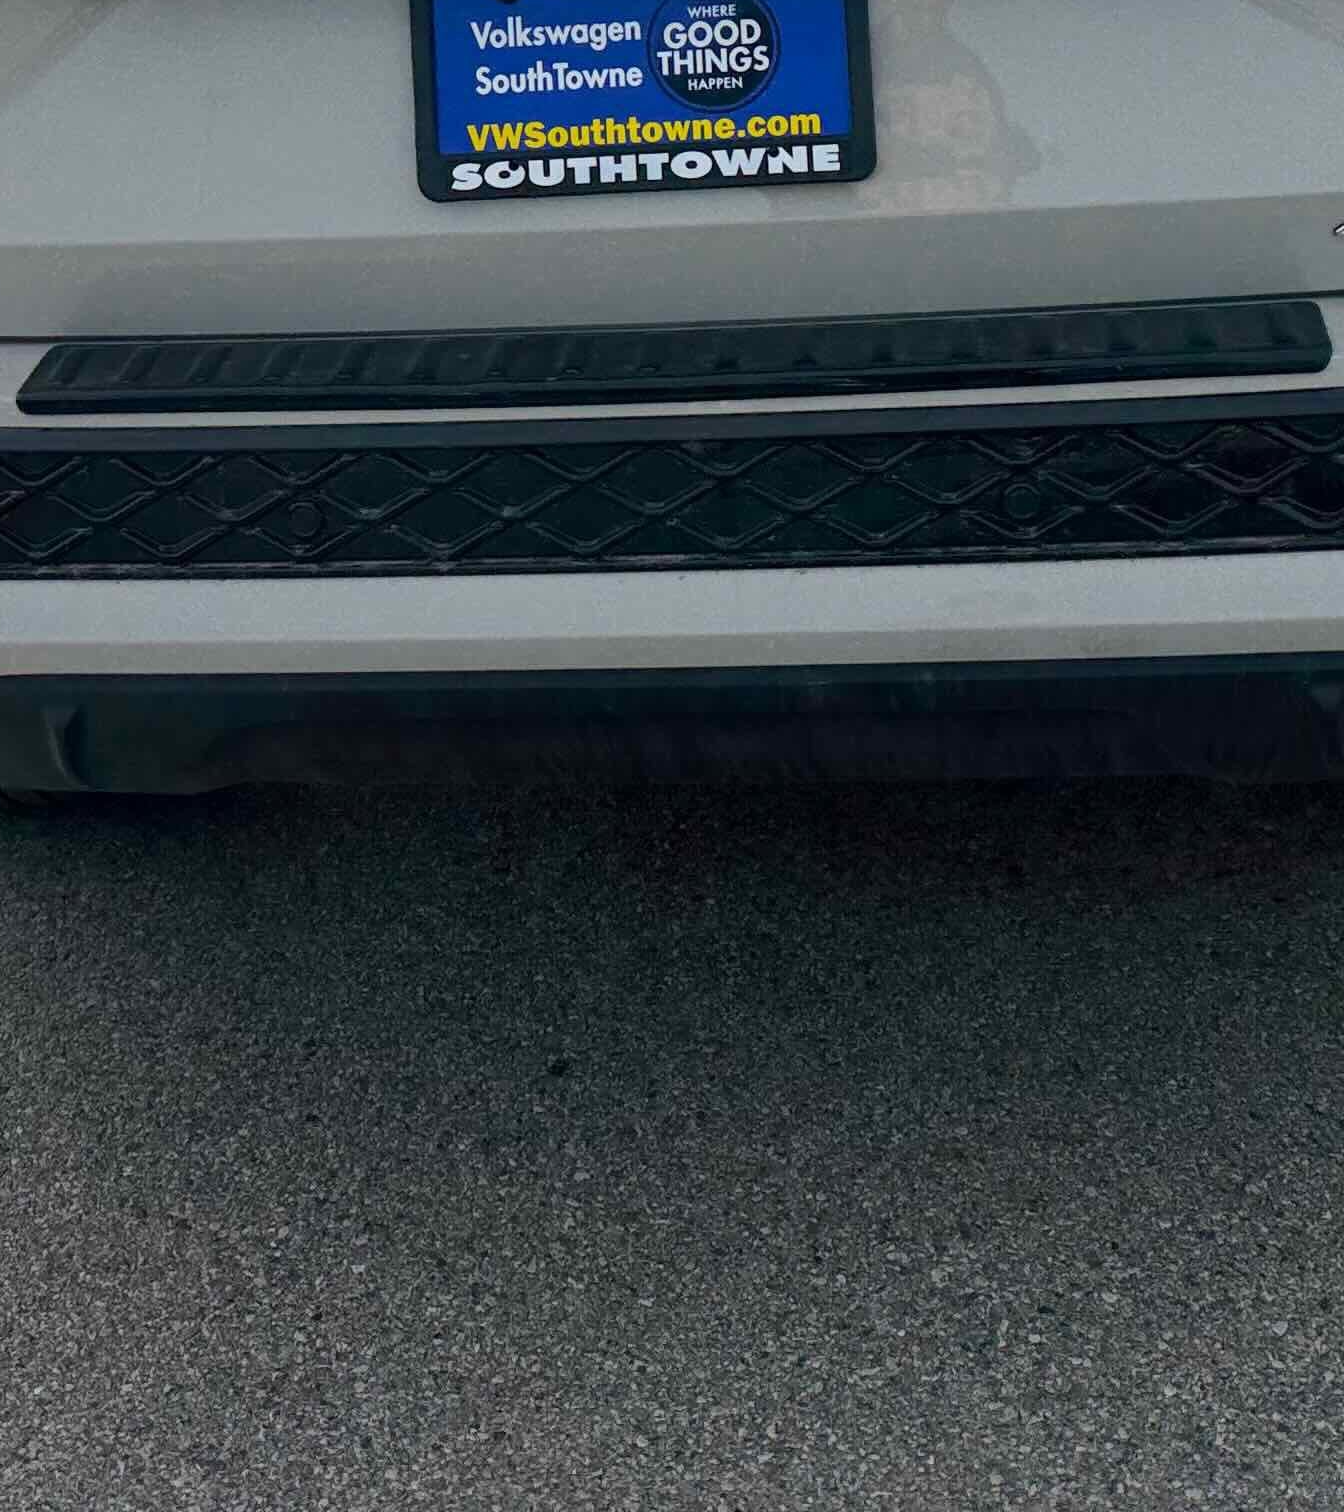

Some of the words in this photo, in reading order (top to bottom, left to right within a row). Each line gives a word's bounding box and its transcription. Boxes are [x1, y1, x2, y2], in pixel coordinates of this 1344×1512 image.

[687, 4, 736, 18] WHERE
[470, 16, 642, 51] Volkswagen
[663, 19, 761, 49] GOOD
[657, 46, 770, 76] THINGS
[475, 60, 644, 96] SouthTowne
[688, 77, 743, 91] HAPPEN
[466, 113, 821, 152] VWSouthtowne.com
[451, 144, 841, 191] SOUTHTOWNE
